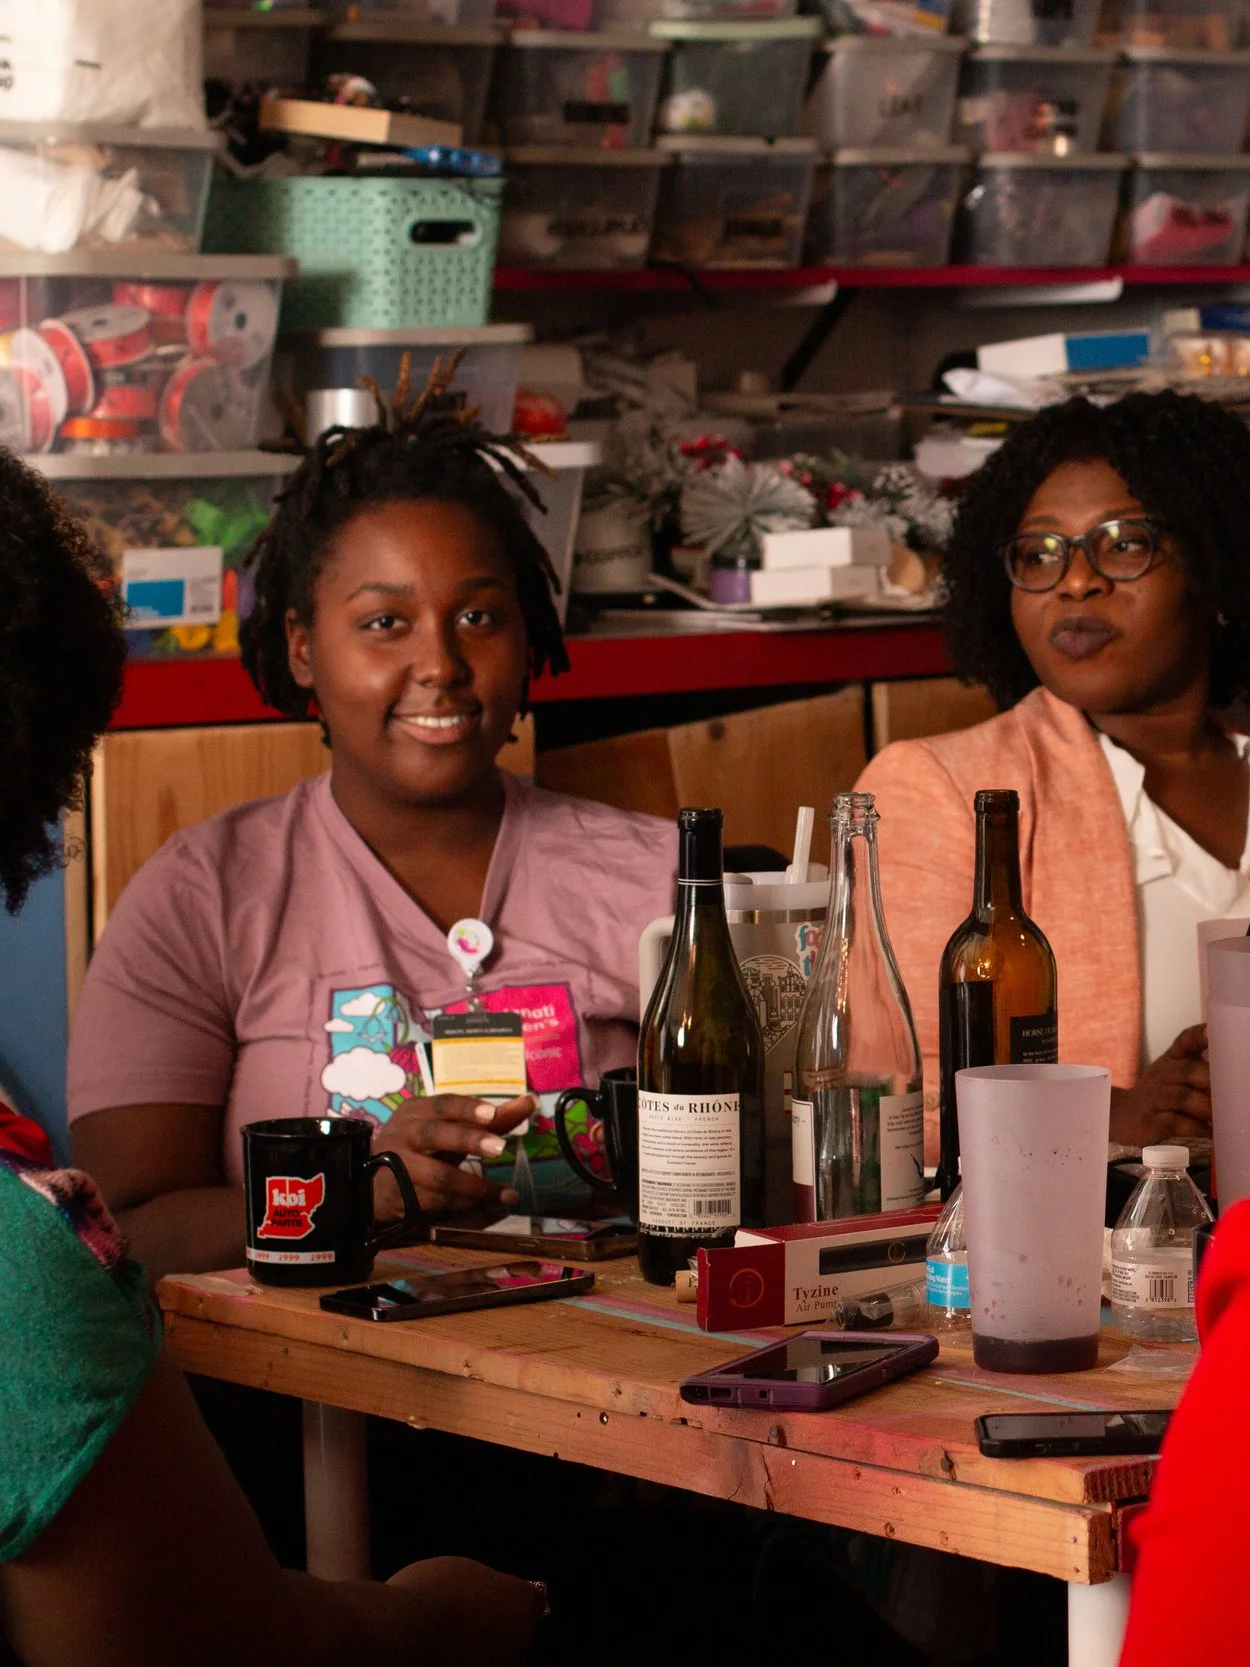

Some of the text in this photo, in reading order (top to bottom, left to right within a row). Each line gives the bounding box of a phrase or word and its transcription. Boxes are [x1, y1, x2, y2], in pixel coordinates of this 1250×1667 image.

[639, 1097, 670, 1112] ÔTES
[673, 1103, 684, 1111] du
[271, 1219, 302, 1227] PARTS
[793, 1285, 838, 1303] Tyzine
[796, 1303, 811, 1312] Air
